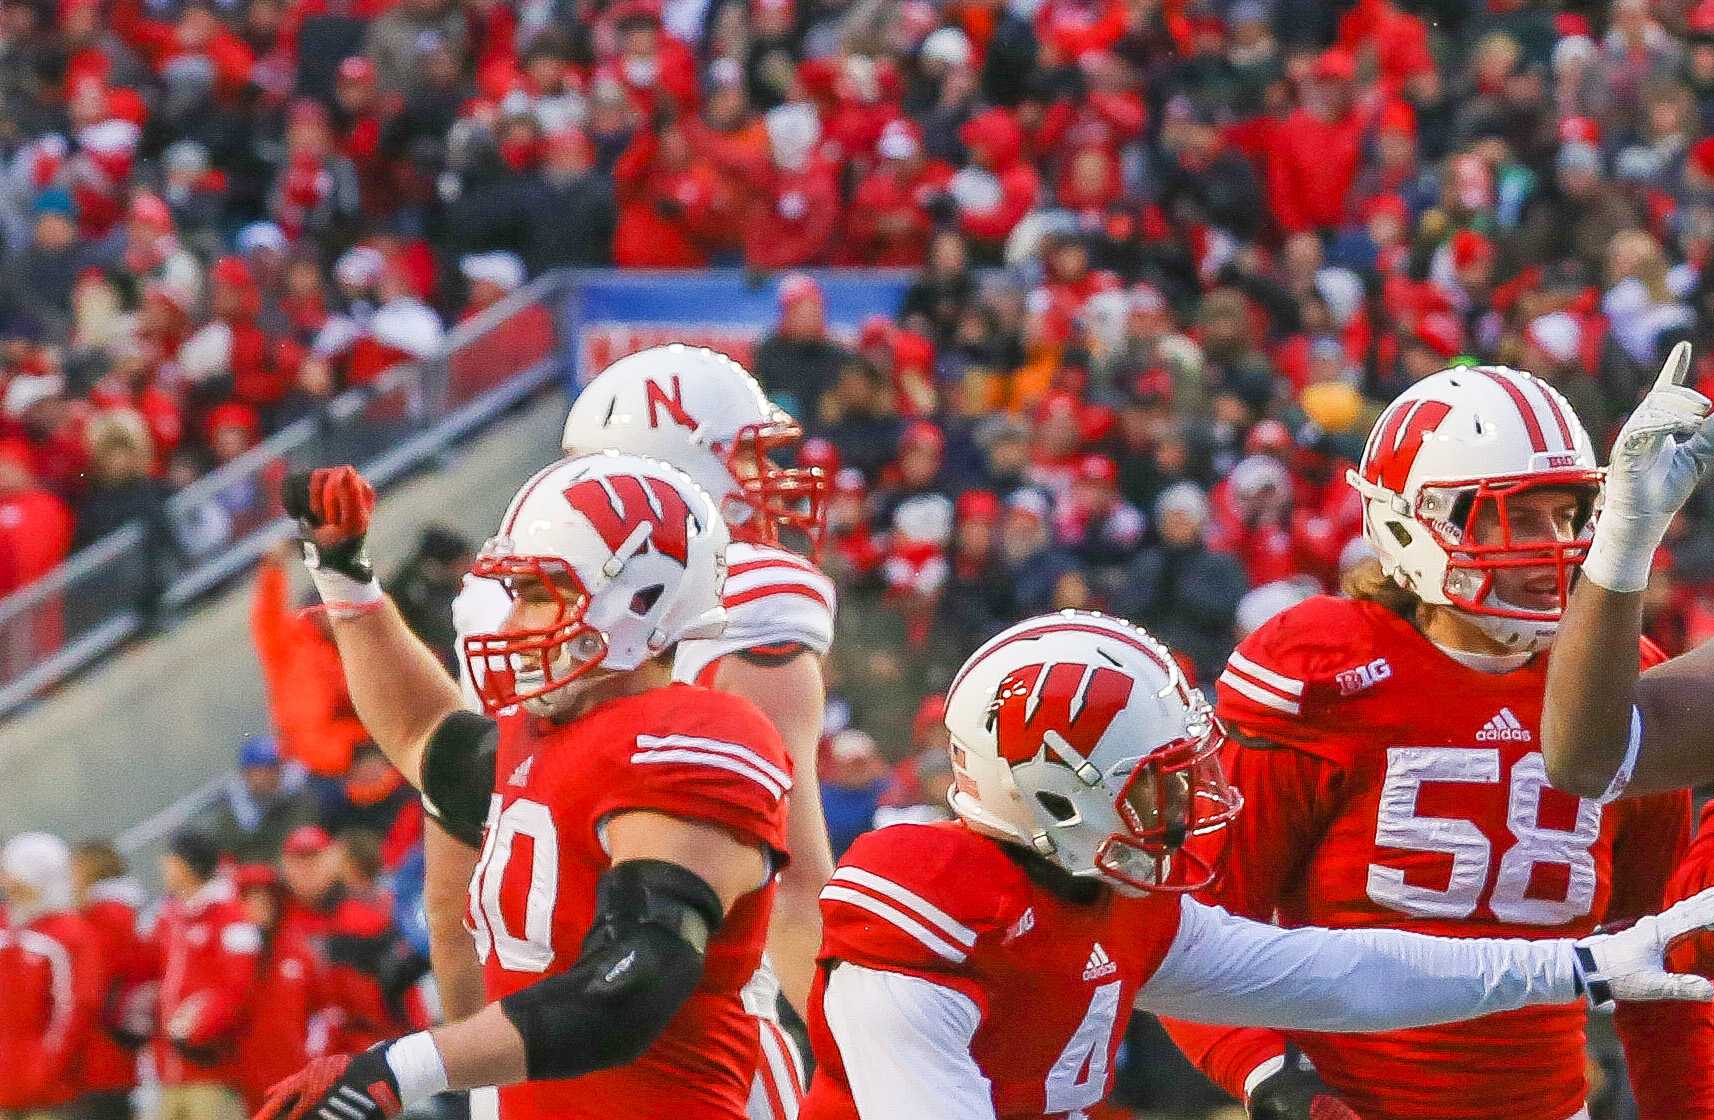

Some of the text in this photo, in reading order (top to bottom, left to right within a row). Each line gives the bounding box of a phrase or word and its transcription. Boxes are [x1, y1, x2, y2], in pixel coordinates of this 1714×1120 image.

[644, 375, 699, 432] N
[564, 475, 688, 570] W
[996, 662, 1135, 767] W
[1475, 728, 1532, 742] adidas
[1366, 747, 1603, 926] 58
